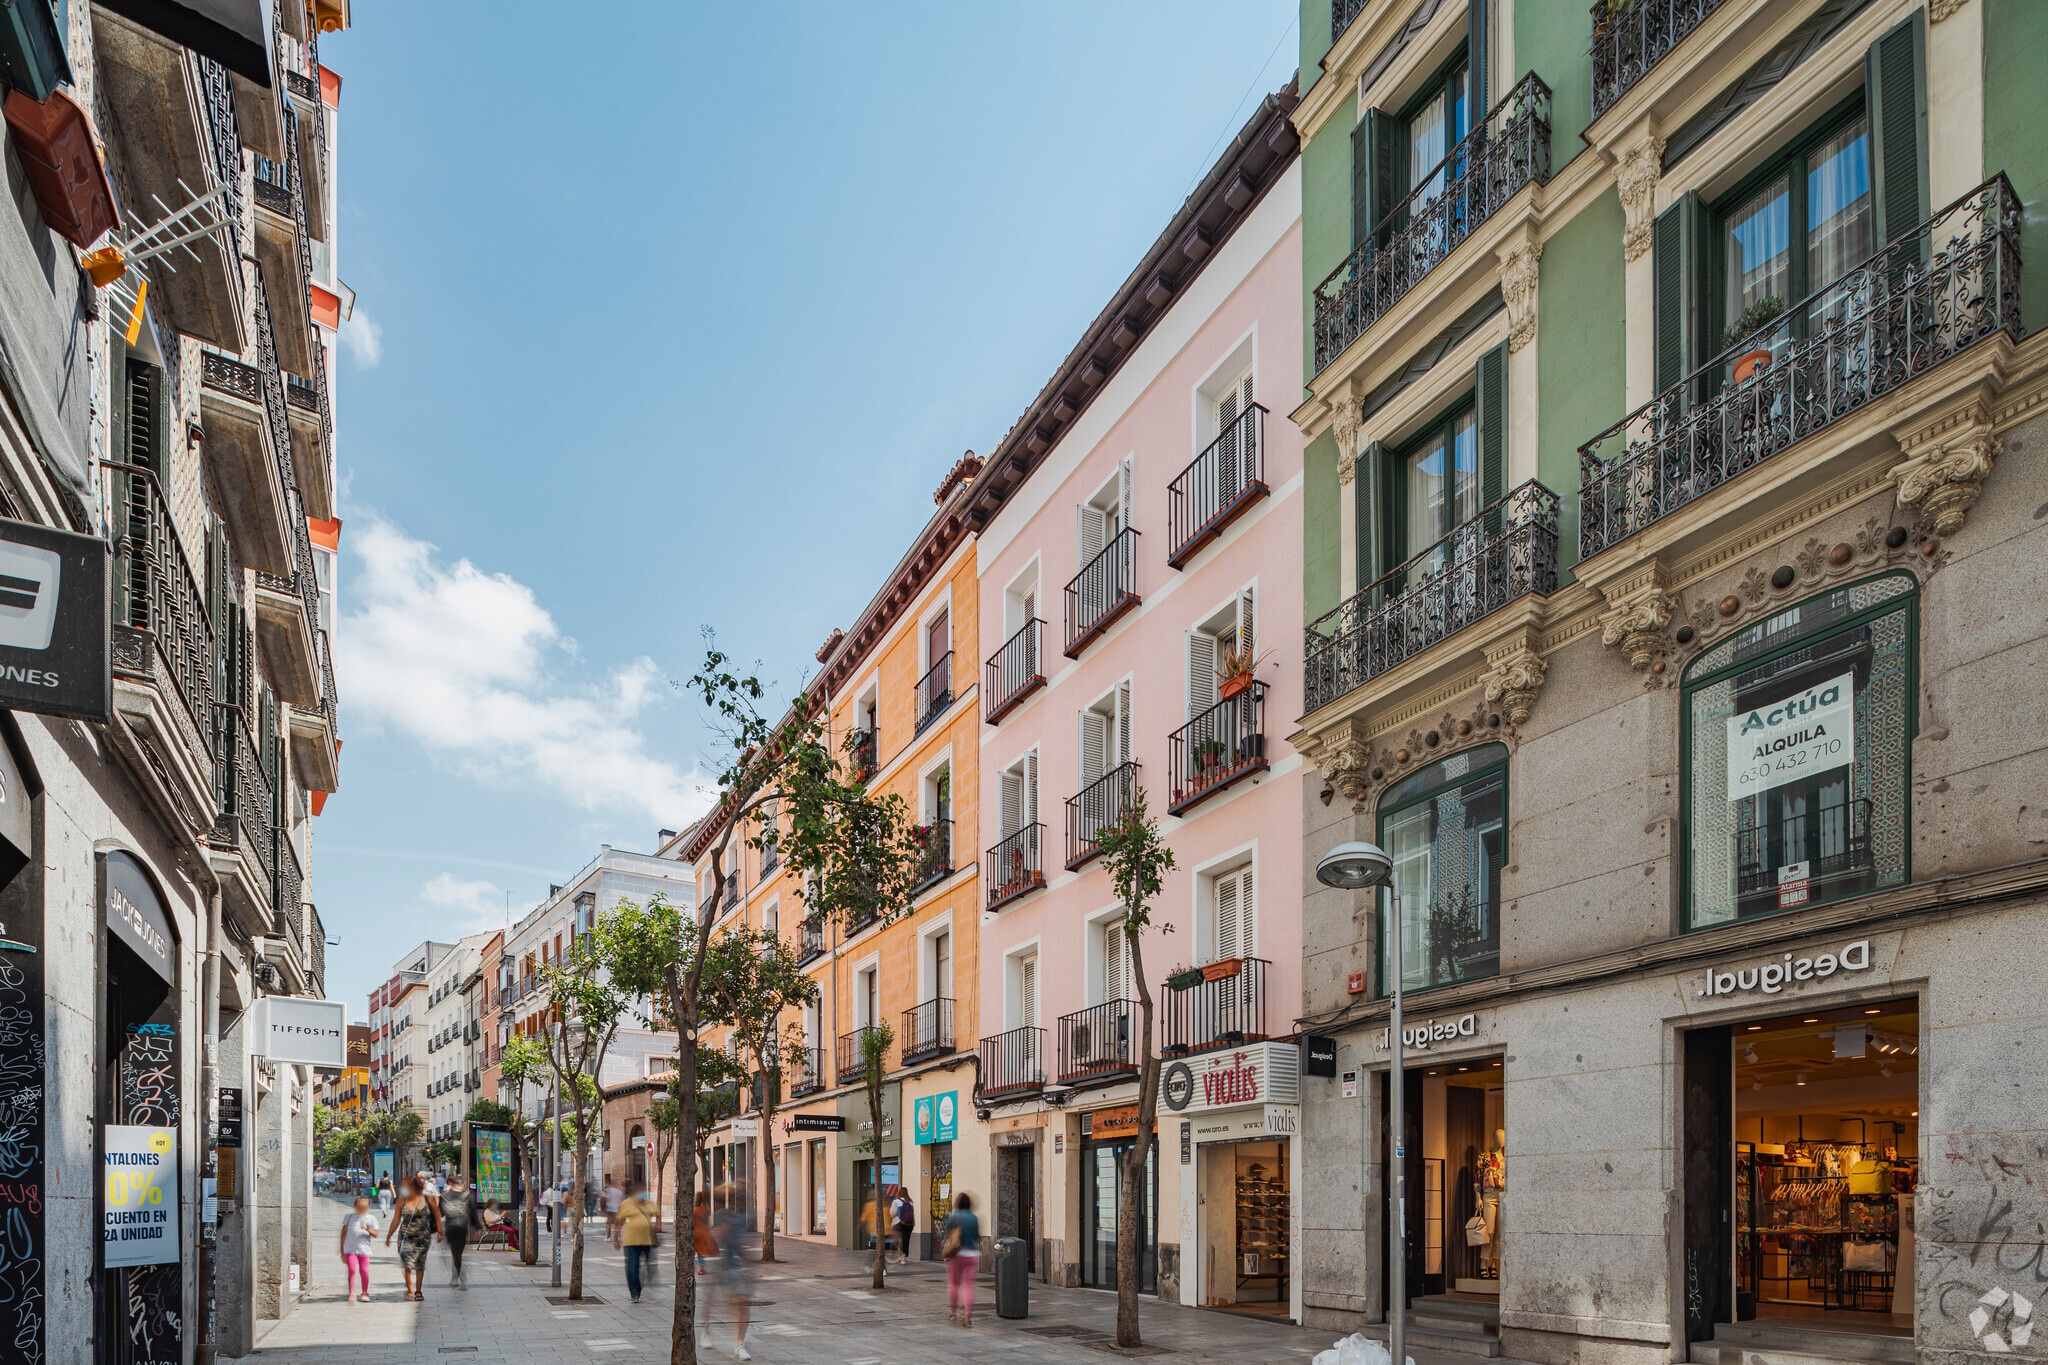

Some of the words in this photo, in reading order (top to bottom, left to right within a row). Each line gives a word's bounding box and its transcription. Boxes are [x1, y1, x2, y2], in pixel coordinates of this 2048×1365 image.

[1740, 685, 1840, 736] Actúa
[1752, 724, 1826, 760] ALQUILA
[1740, 763, 1770, 784] 630
[1775, 750, 1807, 771] 432
[1812, 738, 1841, 760] 710
[1780, 880, 1807, 891] Alarma
[110, 886, 135, 928] JACK
[142, 920, 167, 959] JONES
[272, 1024, 325, 1036] TIFFOSI
[1170, 1080, 1186, 1093] aro
[1202, 1051, 1257, 1106] vialis
[1197, 1124, 1229, 1135] www.aro.es
[1243, 1121, 1264, 1130] www.v
[1268, 1109, 1296, 1133] vialis
[153, 1210, 167, 1223] EN
